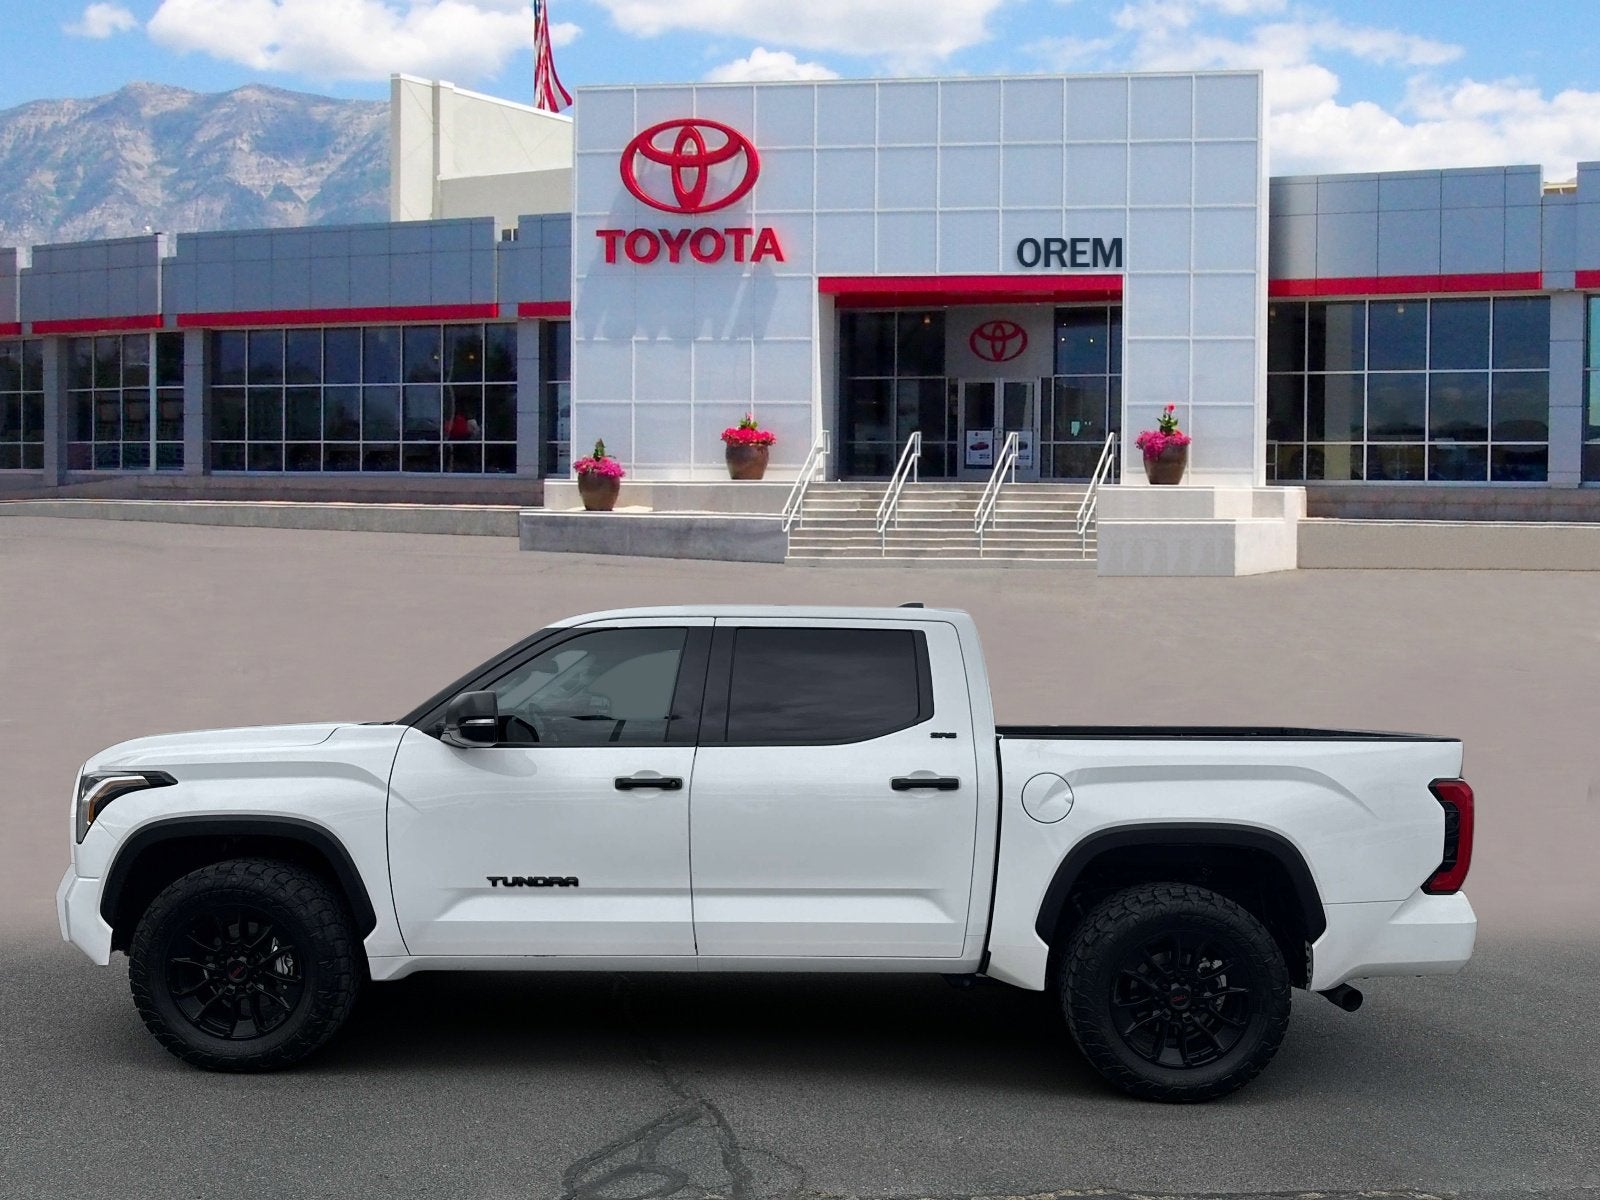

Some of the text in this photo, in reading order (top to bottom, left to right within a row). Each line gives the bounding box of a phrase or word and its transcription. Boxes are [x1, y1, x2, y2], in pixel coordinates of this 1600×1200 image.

[596, 227, 785, 265] TOYOTA
[1017, 237, 1123, 268] OREM
[486, 876, 579, 887] TUNDRA
